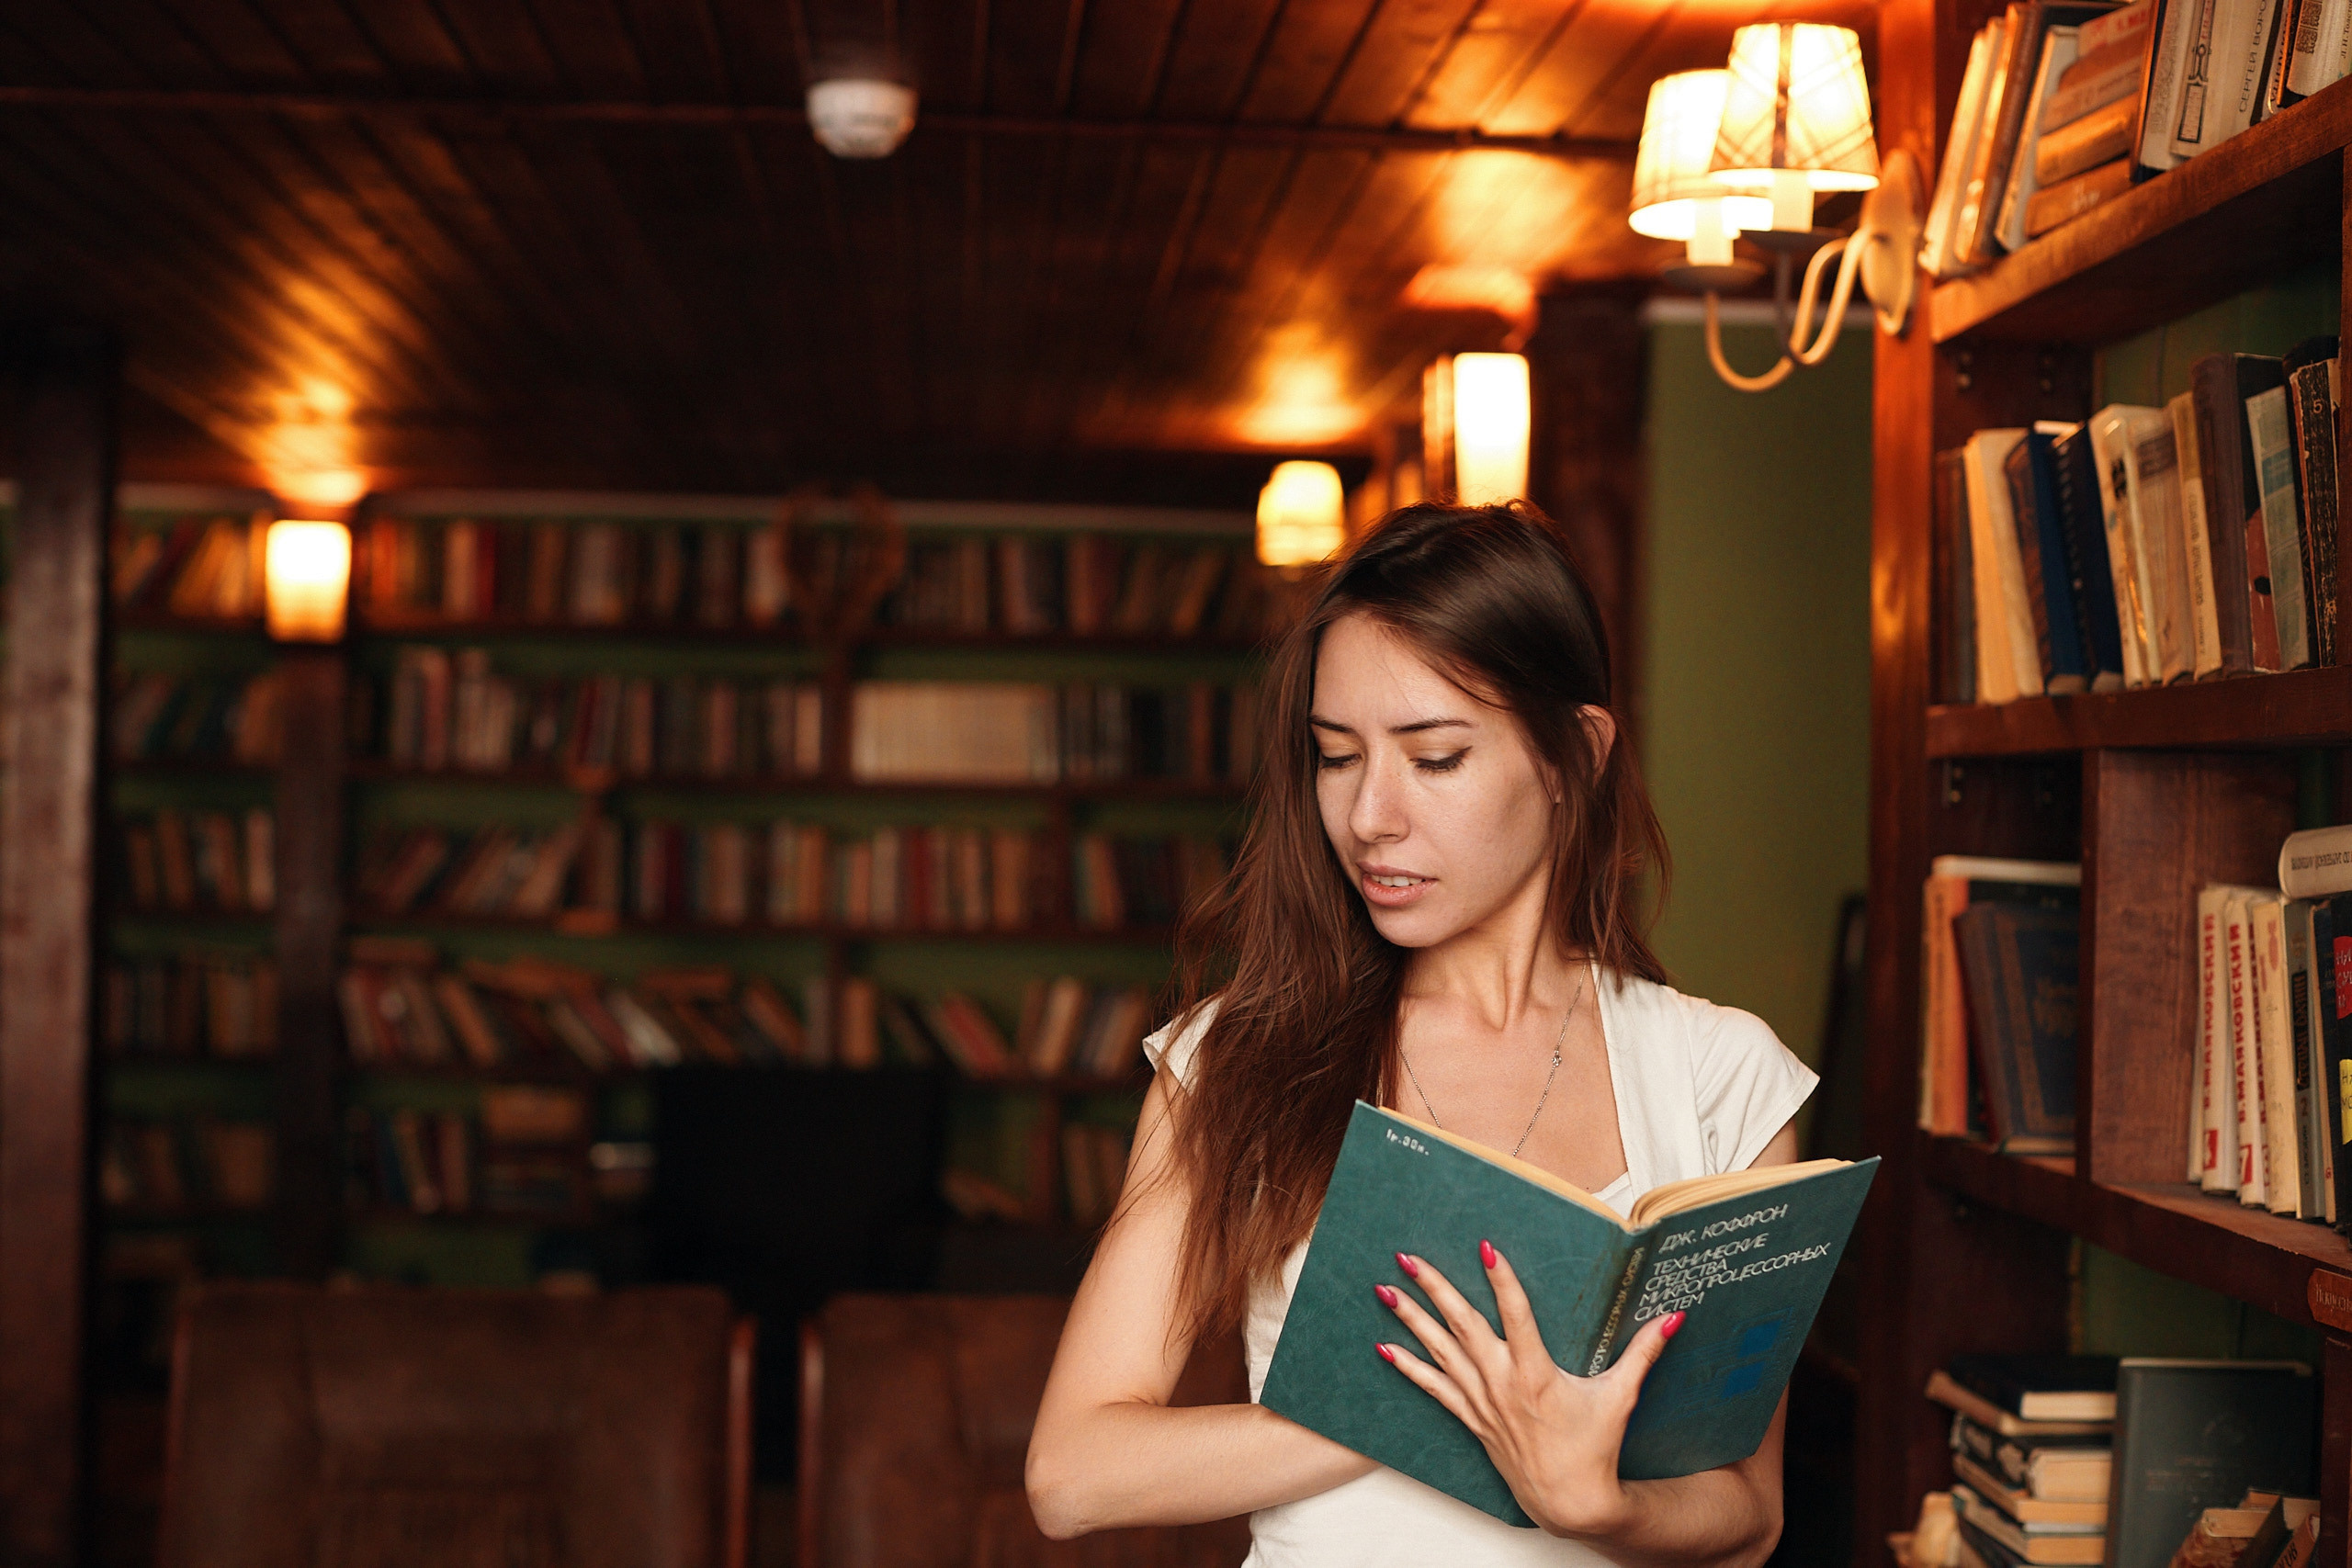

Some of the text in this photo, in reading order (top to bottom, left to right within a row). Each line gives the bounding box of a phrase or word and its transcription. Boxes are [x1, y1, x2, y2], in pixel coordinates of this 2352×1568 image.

[1658, 1203, 1788, 1255] ДЖ. КОФФРОН
[1638, 1242, 1832, 1307] МИКРОПРОЦЕССОРНЫХ
[1645, 1258, 1727, 1292] СРЕДСТВА
[1653, 1232, 1770, 1277] ТЕХНИЧЕСКИЕ
[1634, 1291, 1705, 1322] СИСТЕМ
